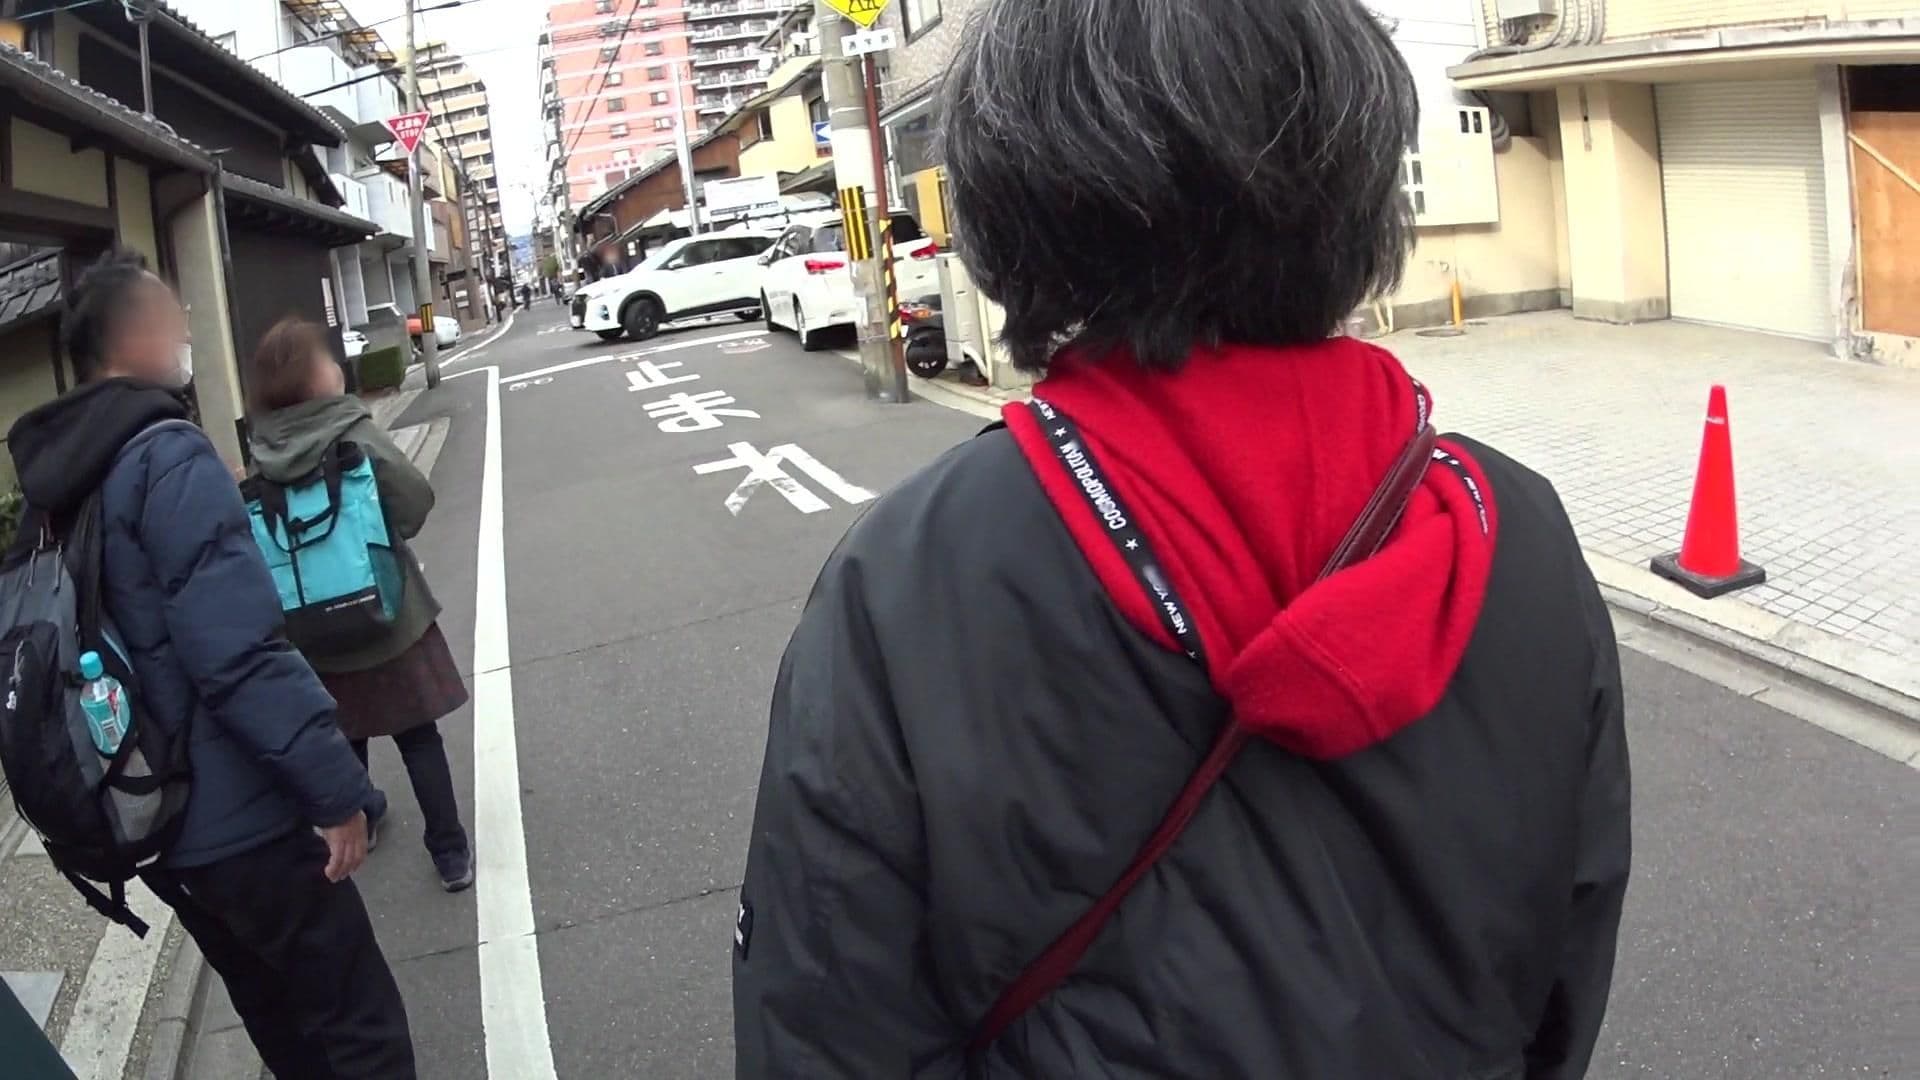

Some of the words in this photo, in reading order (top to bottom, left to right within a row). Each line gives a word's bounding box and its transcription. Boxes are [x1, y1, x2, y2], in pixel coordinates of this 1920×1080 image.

[626, 360, 878, 516] 止まれ
[1164, 601, 1187, 635] NEW
